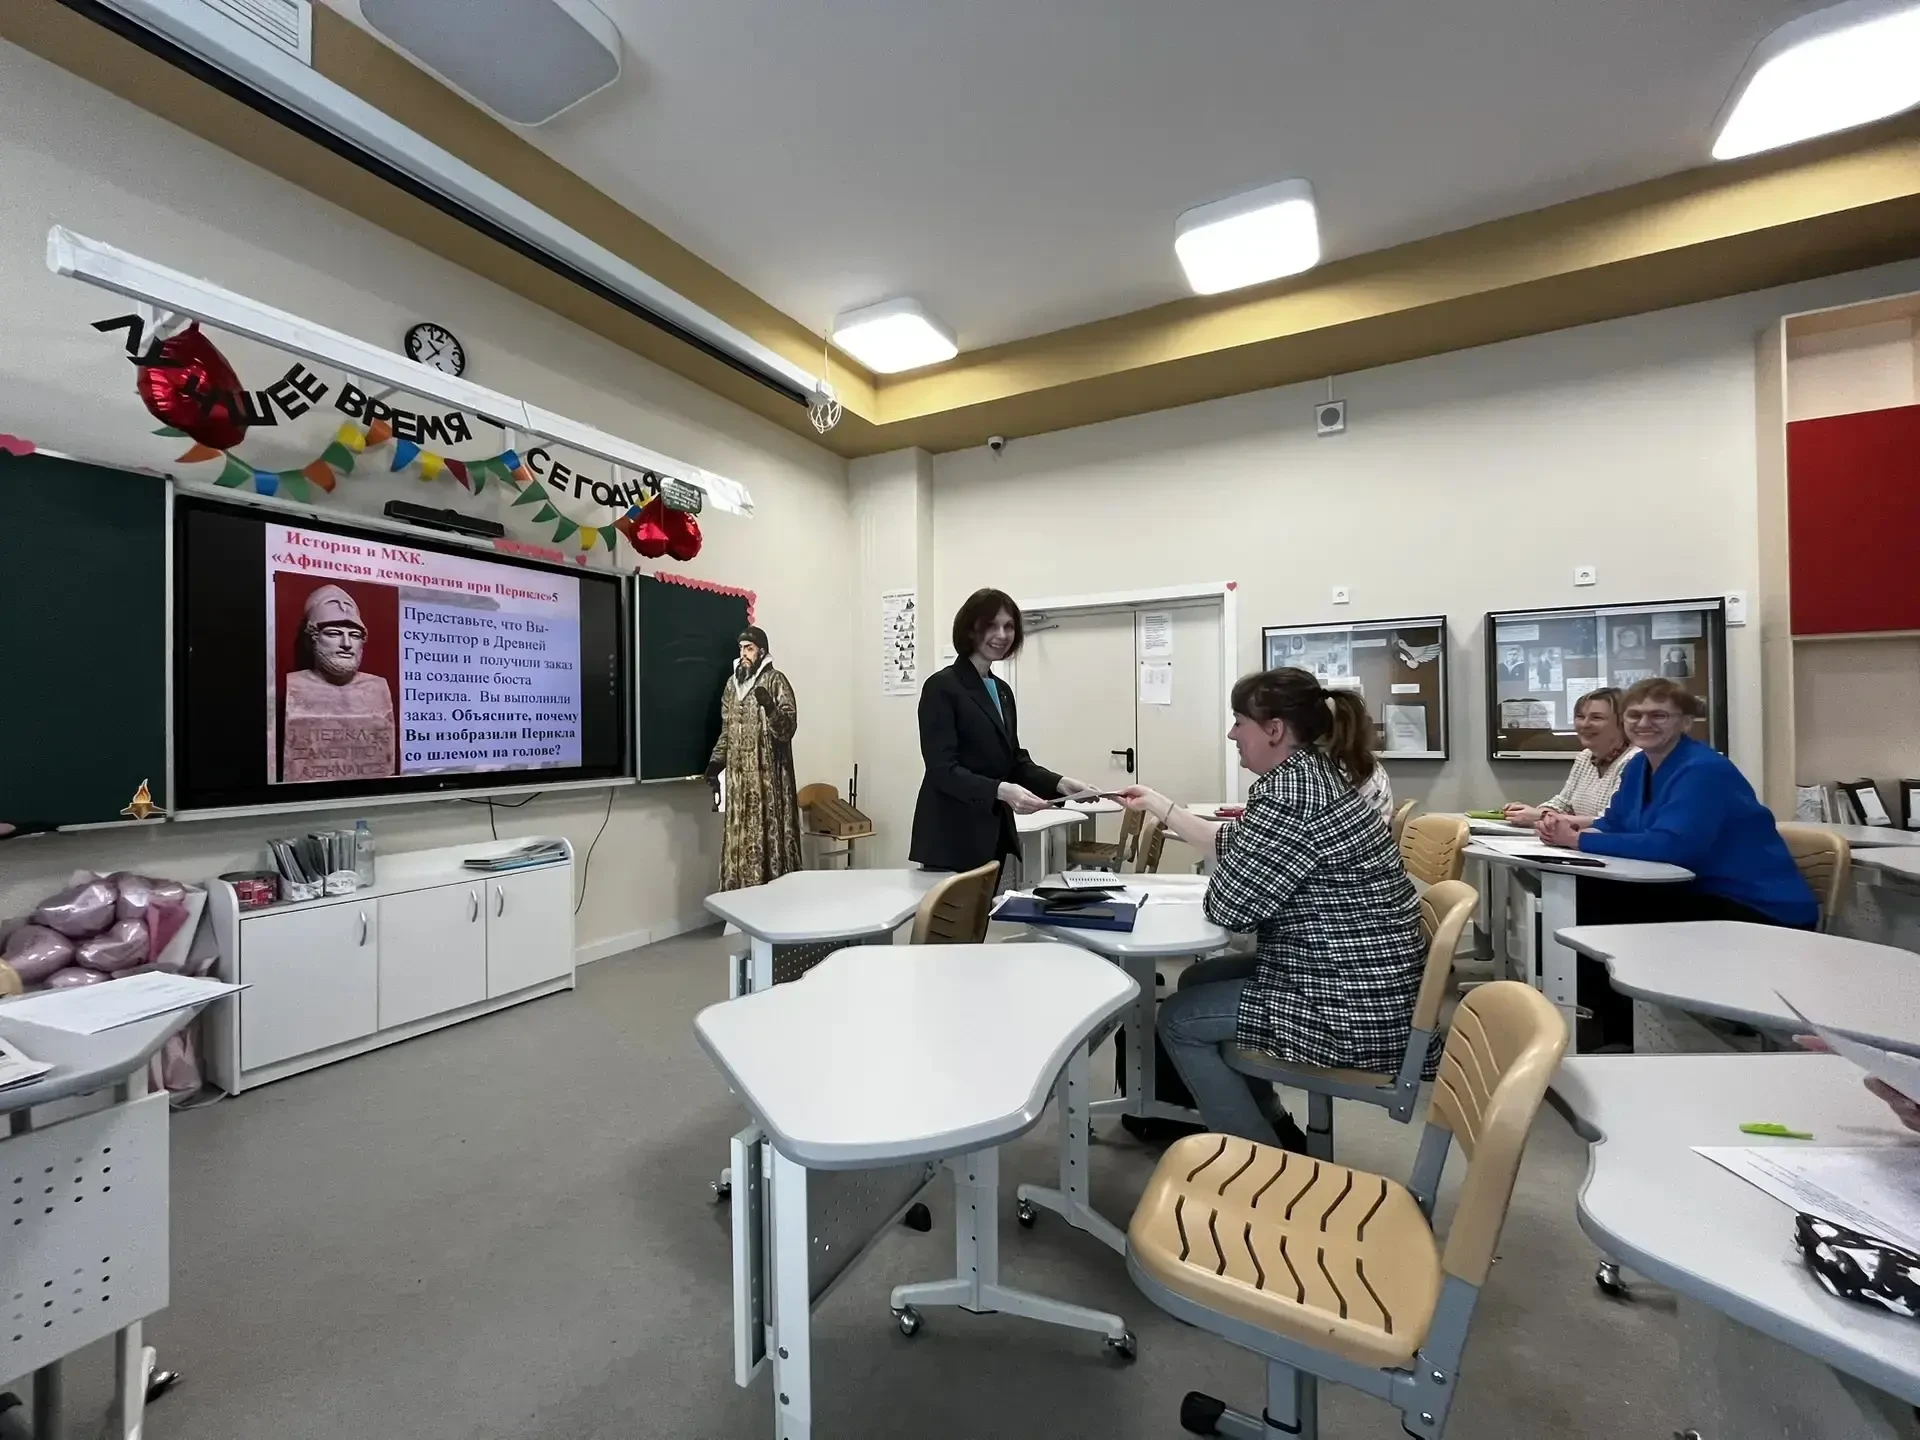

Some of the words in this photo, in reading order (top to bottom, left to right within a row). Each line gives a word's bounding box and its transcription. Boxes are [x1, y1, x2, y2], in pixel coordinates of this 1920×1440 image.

[427, 327, 445, 345] 12
[334, 382, 473, 445] ВРЕМЯ
[526, 447, 662, 509] СЕГОДНЯ
[286, 531, 361, 554] История
[367, 548, 376, 557] и
[381, 547, 425, 565] МХК.
[272, 552, 372, 575] «Афинская
[376, 568, 463, 589] демократия
[467, 581, 491, 594] при
[404, 606, 497, 630] Представьте,
[501, 620, 522, 631] что
[526, 620, 549, 633] Вы-
[404, 630, 479, 648] скульптор
[483, 637, 490, 646] в
[494, 635, 546, 651] Древней
[404, 647, 458, 664] Греции
[463, 655, 471, 664] и
[480, 656, 541, 670] получили
[544, 660, 573, 670] заказ
[404, 671, 422, 682] на
[426, 671, 490, 684] создание
[493, 672, 532, 685] бюста
[404, 688, 471, 704] Перикла.
[480, 691, 500, 703] Вы
[504, 694, 571, 704] выполнили
[404, 711, 447, 722] заказ.
[451, 709, 532, 724] Объясните,
[535, 712, 579, 724] почему
[405, 728, 430, 742] Вы
[436, 728, 517, 743] изобразили
[522, 727, 576, 740] Перикла
[405, 751, 422, 762] со
[427, 749, 488, 761] шлемом
[492, 749, 508, 759] на
[512, 744, 561, 757] голове?
